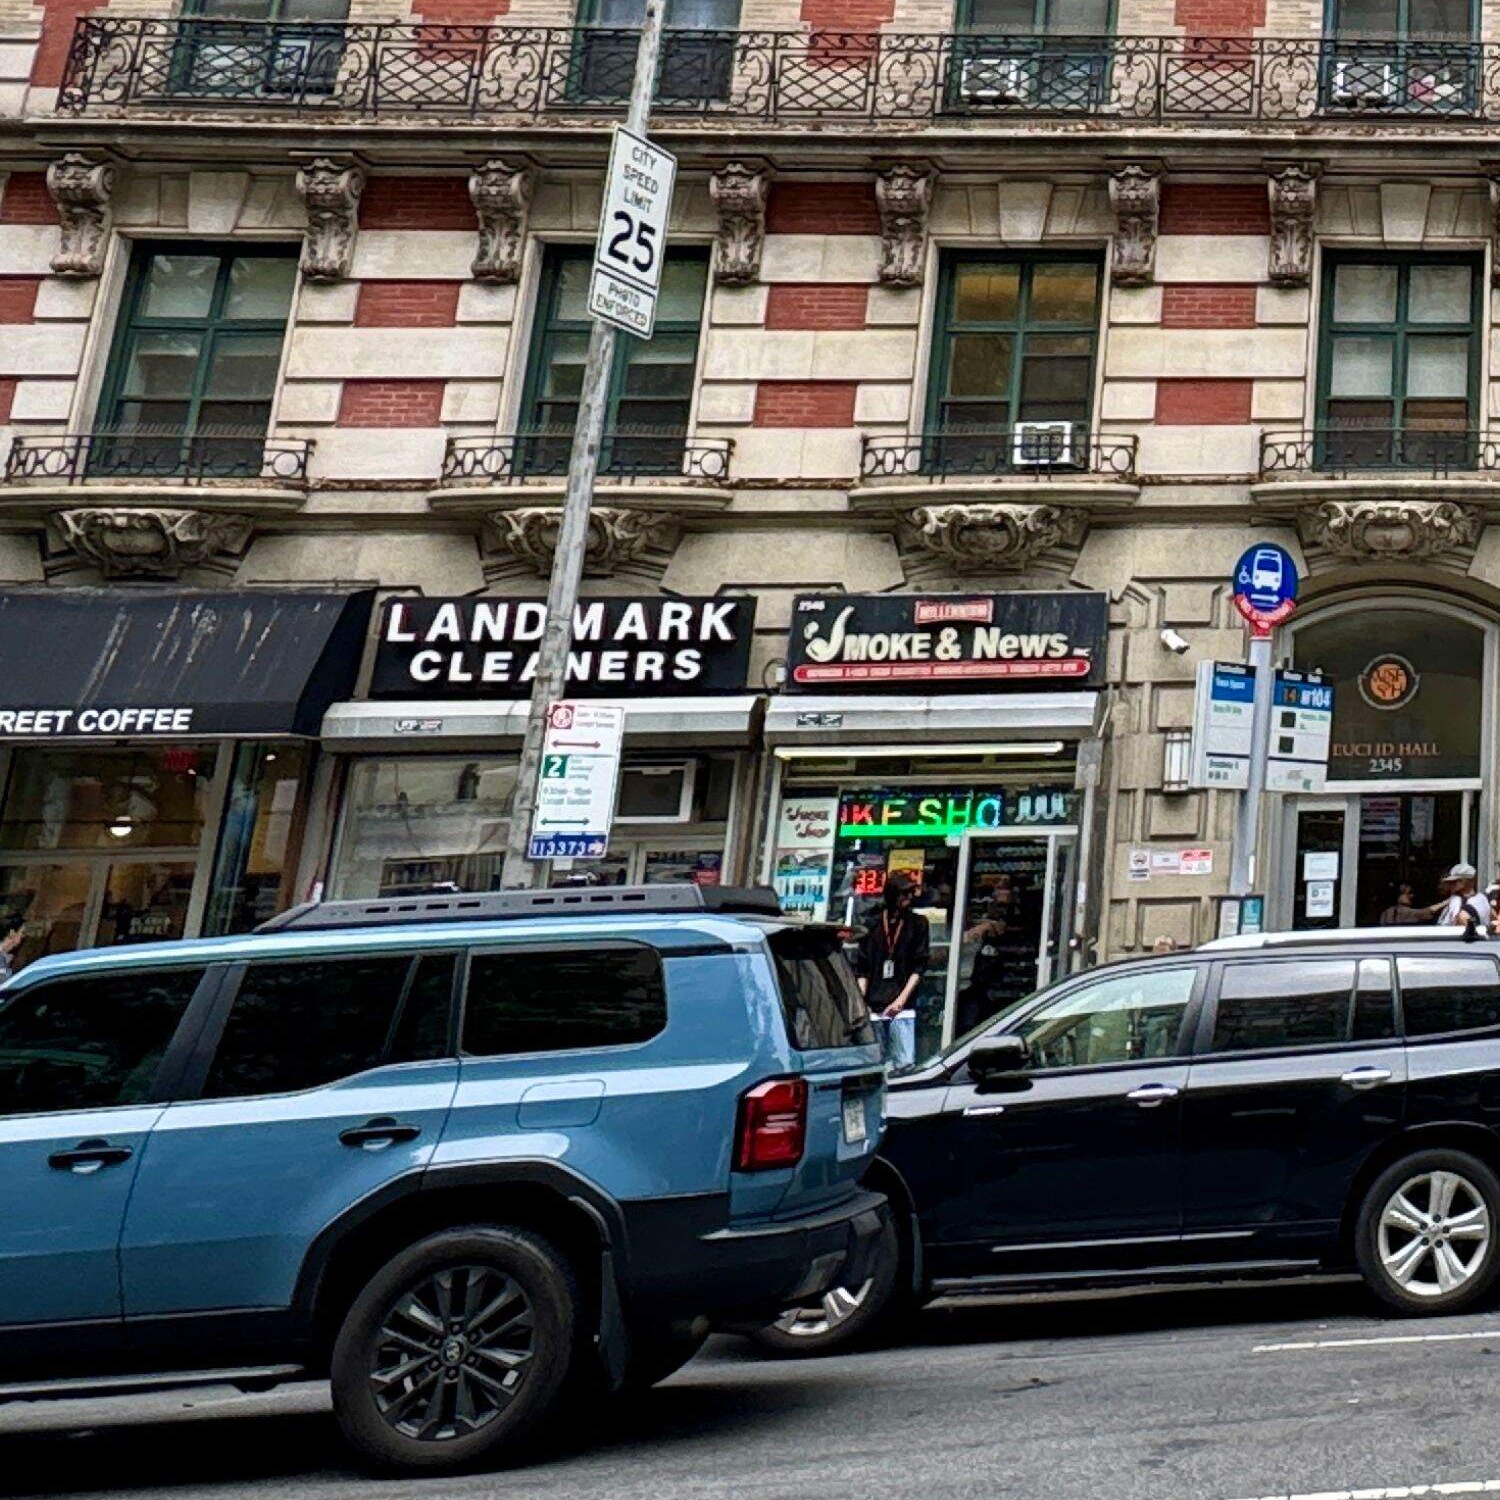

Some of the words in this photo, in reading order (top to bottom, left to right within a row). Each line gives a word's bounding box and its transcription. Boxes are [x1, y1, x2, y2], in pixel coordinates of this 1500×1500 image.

[632, 146, 657, 167] CITY
[623, 164, 658, 195] SPEED
[624, 187, 654, 213] LIMIT
[608, 211, 656, 272] 25
[608, 282, 640, 305] PHOTO
[596, 294, 647, 327] ENFORCED
[387, 601, 738, 643] LANDMARK
[935, 627, 962, 661] &
[972, 627, 1069, 659] News
[409, 649, 702, 683] CLEANERS
[0, 710, 73, 733] REET
[77, 708, 193, 732] COFFEE
[1332, 743, 1395, 756] EUCLID
[1399, 743, 1441, 756] HALL
[547, 756, 563, 778] 2
[1368, 758, 1403, 772] 2345
